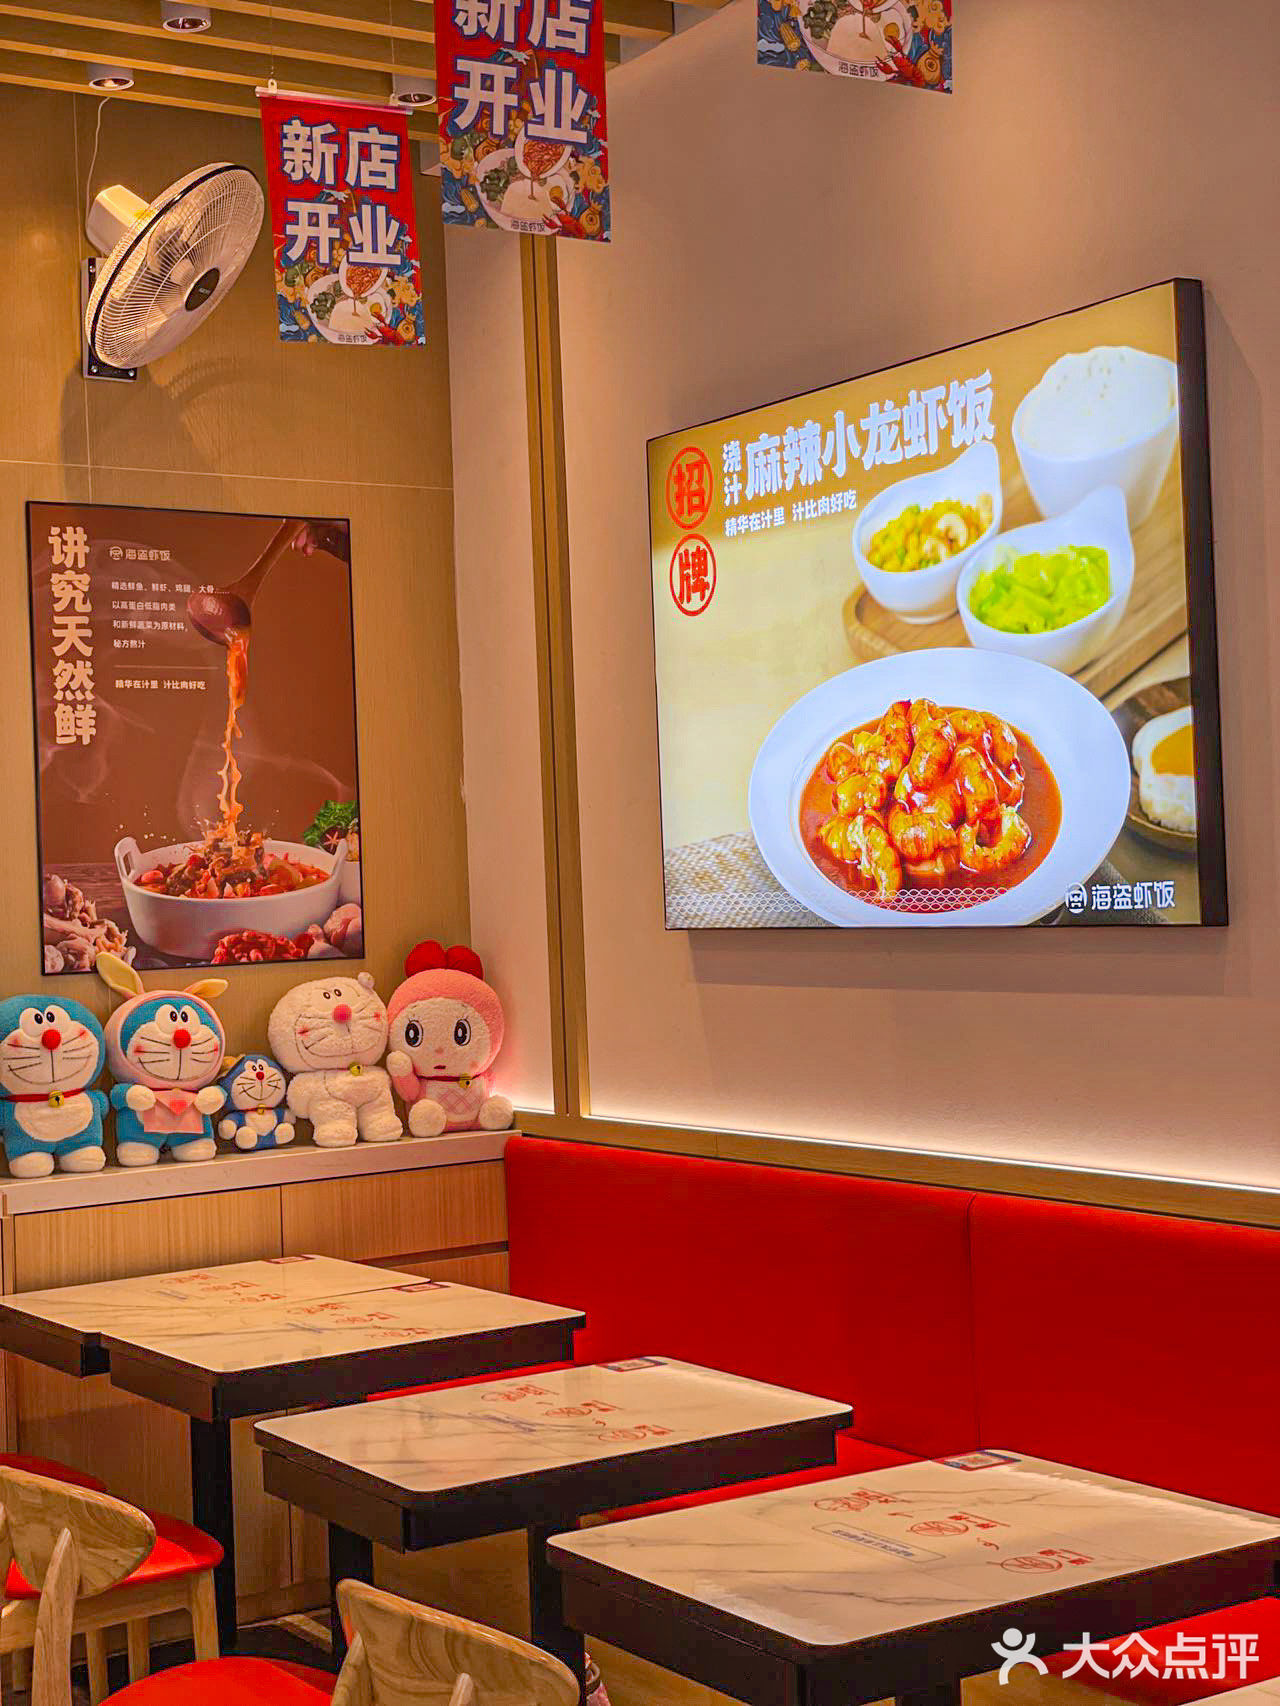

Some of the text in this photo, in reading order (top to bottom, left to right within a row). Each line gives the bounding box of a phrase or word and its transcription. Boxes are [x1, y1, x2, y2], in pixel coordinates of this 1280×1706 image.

[454, 0, 590, 54] 新店
[453, 58, 589, 144] 开业
[281, 119, 399, 191] 新店
[285, 200, 402, 265] 开业
[745, 369, 996, 501] 麻辣小龙虾饭
[722, 440, 743, 507] 浇汁
[673, 458, 710, 605] 招牌
[724, 489, 857, 537] 精华在汁里 汁比肉好吃
[47, 526, 97, 746] 讲究天然鲜
[115, 679, 206, 690] 精华在汁里 汁比肉好吃
[1091, 881, 1176, 910] 海盗虾饭
